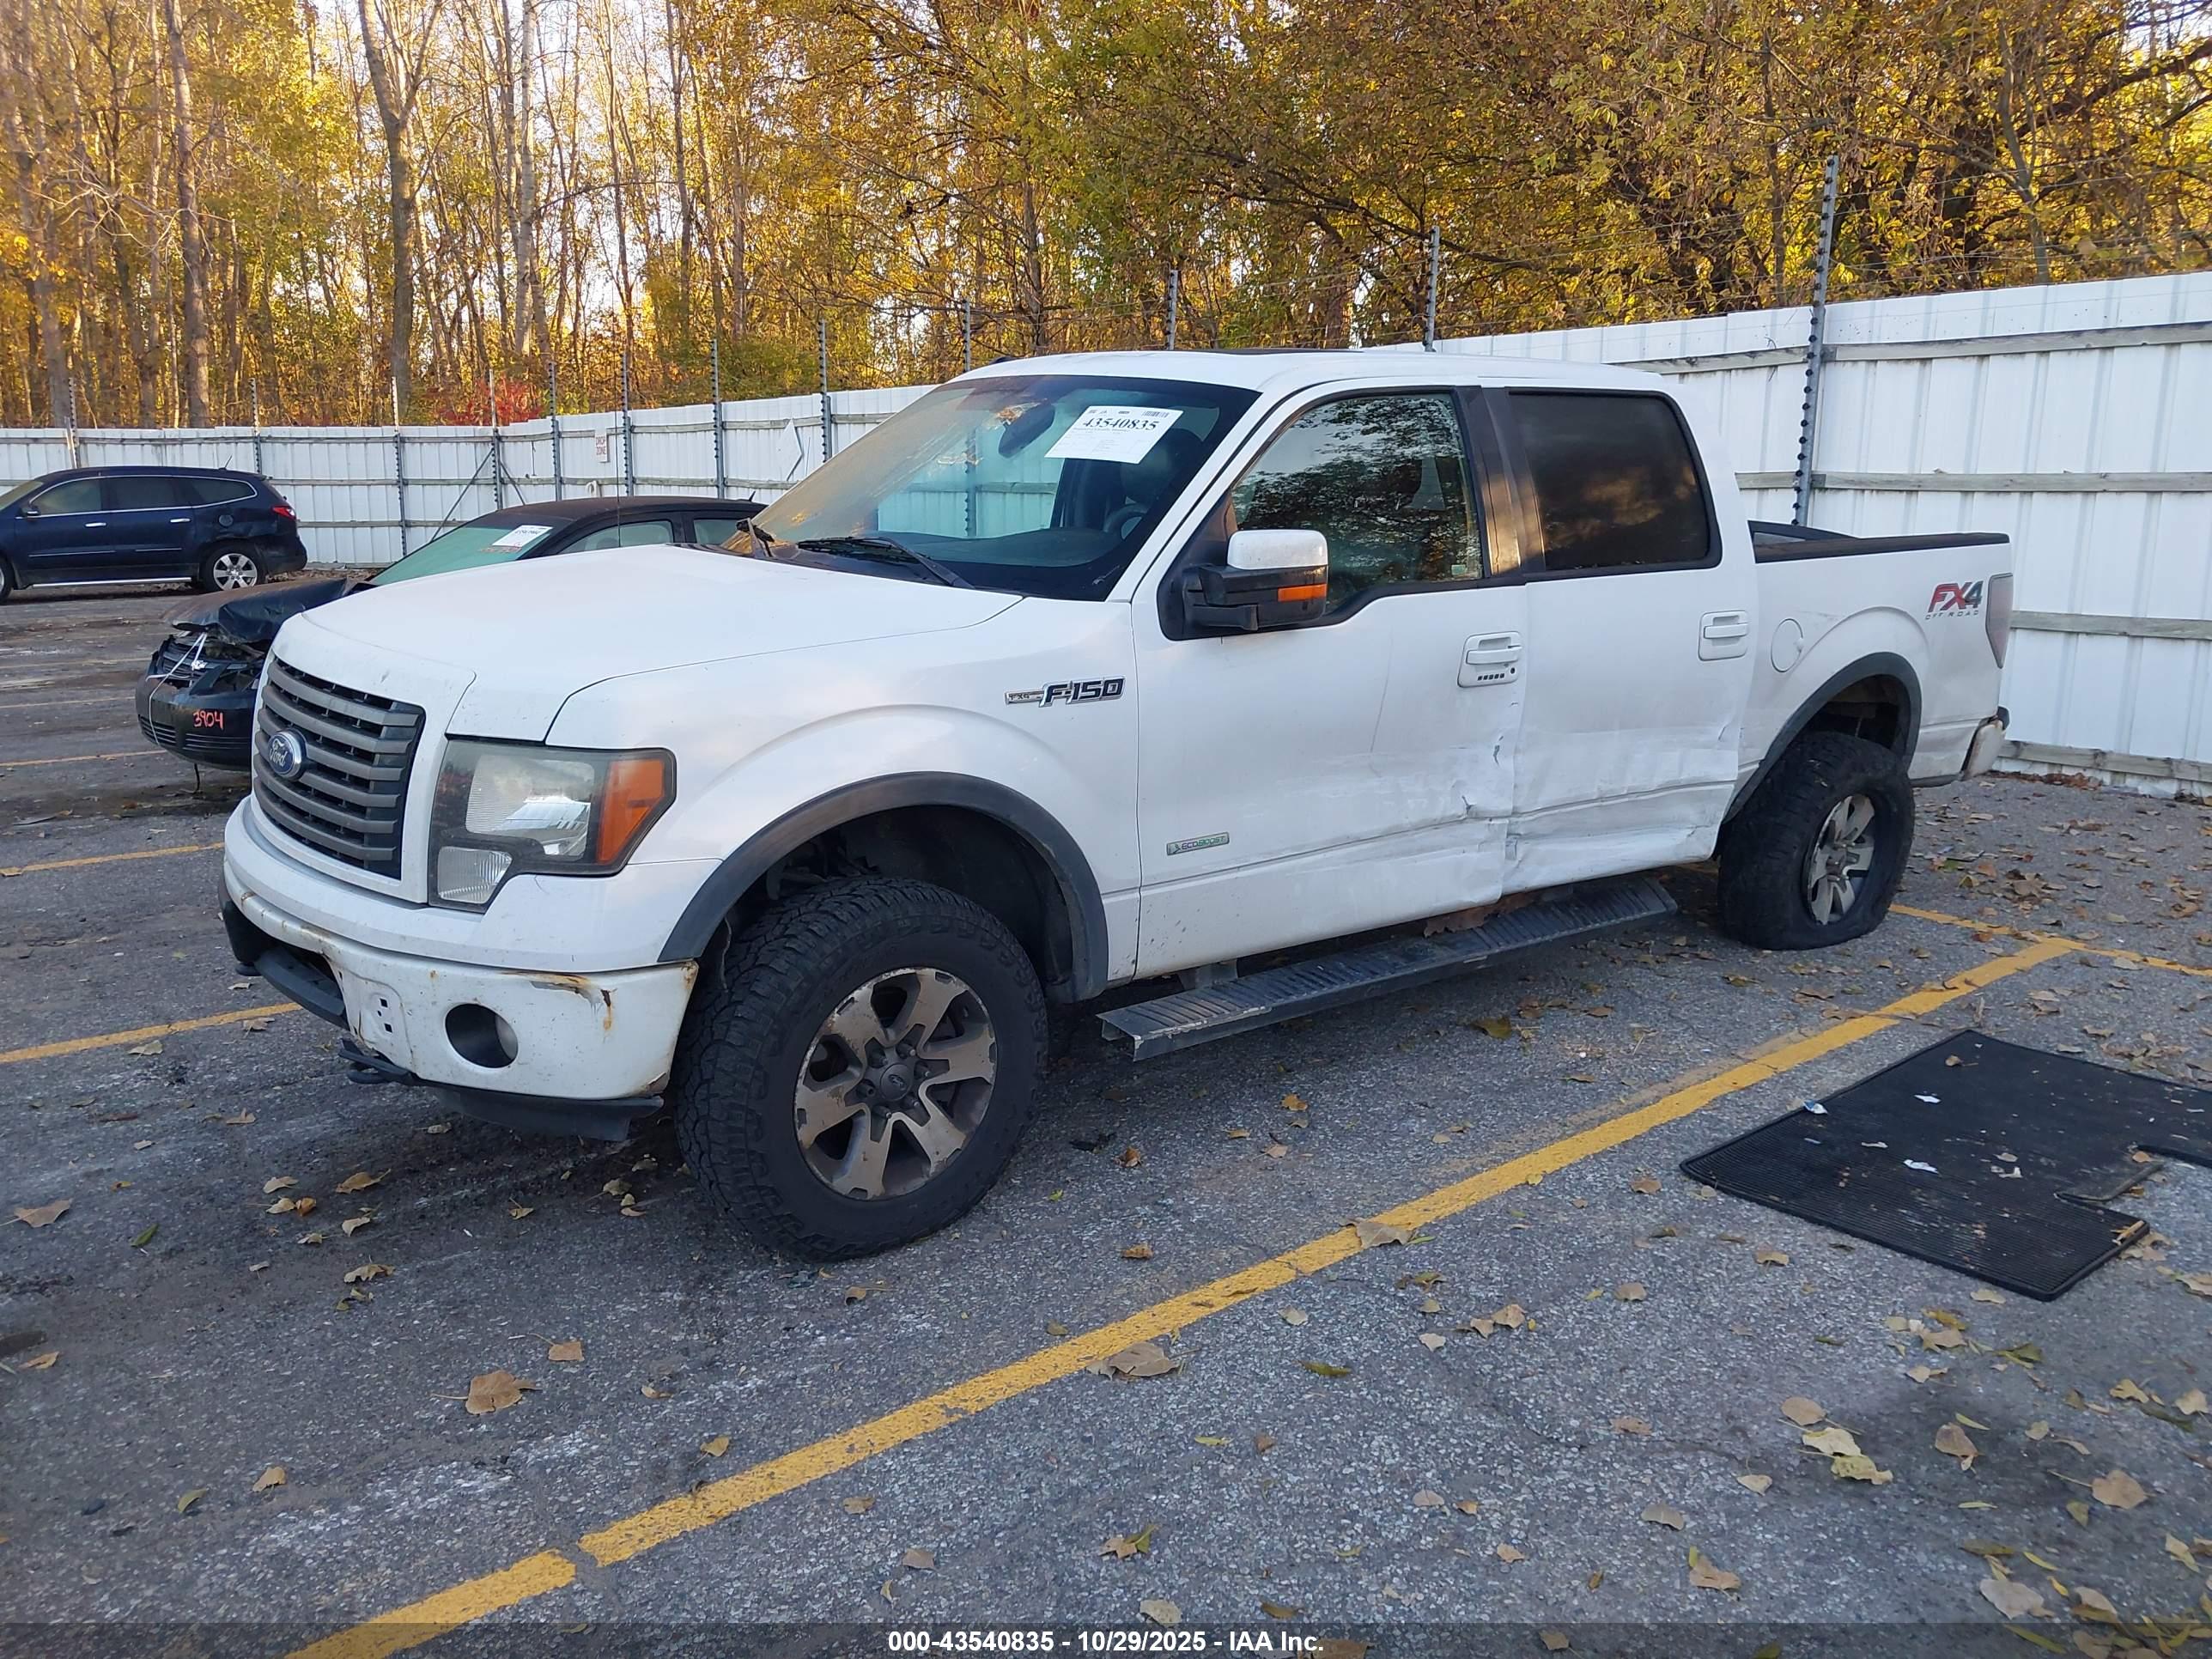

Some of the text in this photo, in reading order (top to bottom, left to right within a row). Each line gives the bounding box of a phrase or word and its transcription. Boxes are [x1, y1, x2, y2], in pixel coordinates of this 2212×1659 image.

[1083, 417, 1159, 430] 43540835
[1928, 580, 1984, 613] FX4
[1038, 676, 1126, 708] F-150
[192, 709, 224, 730] 3904
[269, 738, 289, 768] Ford
